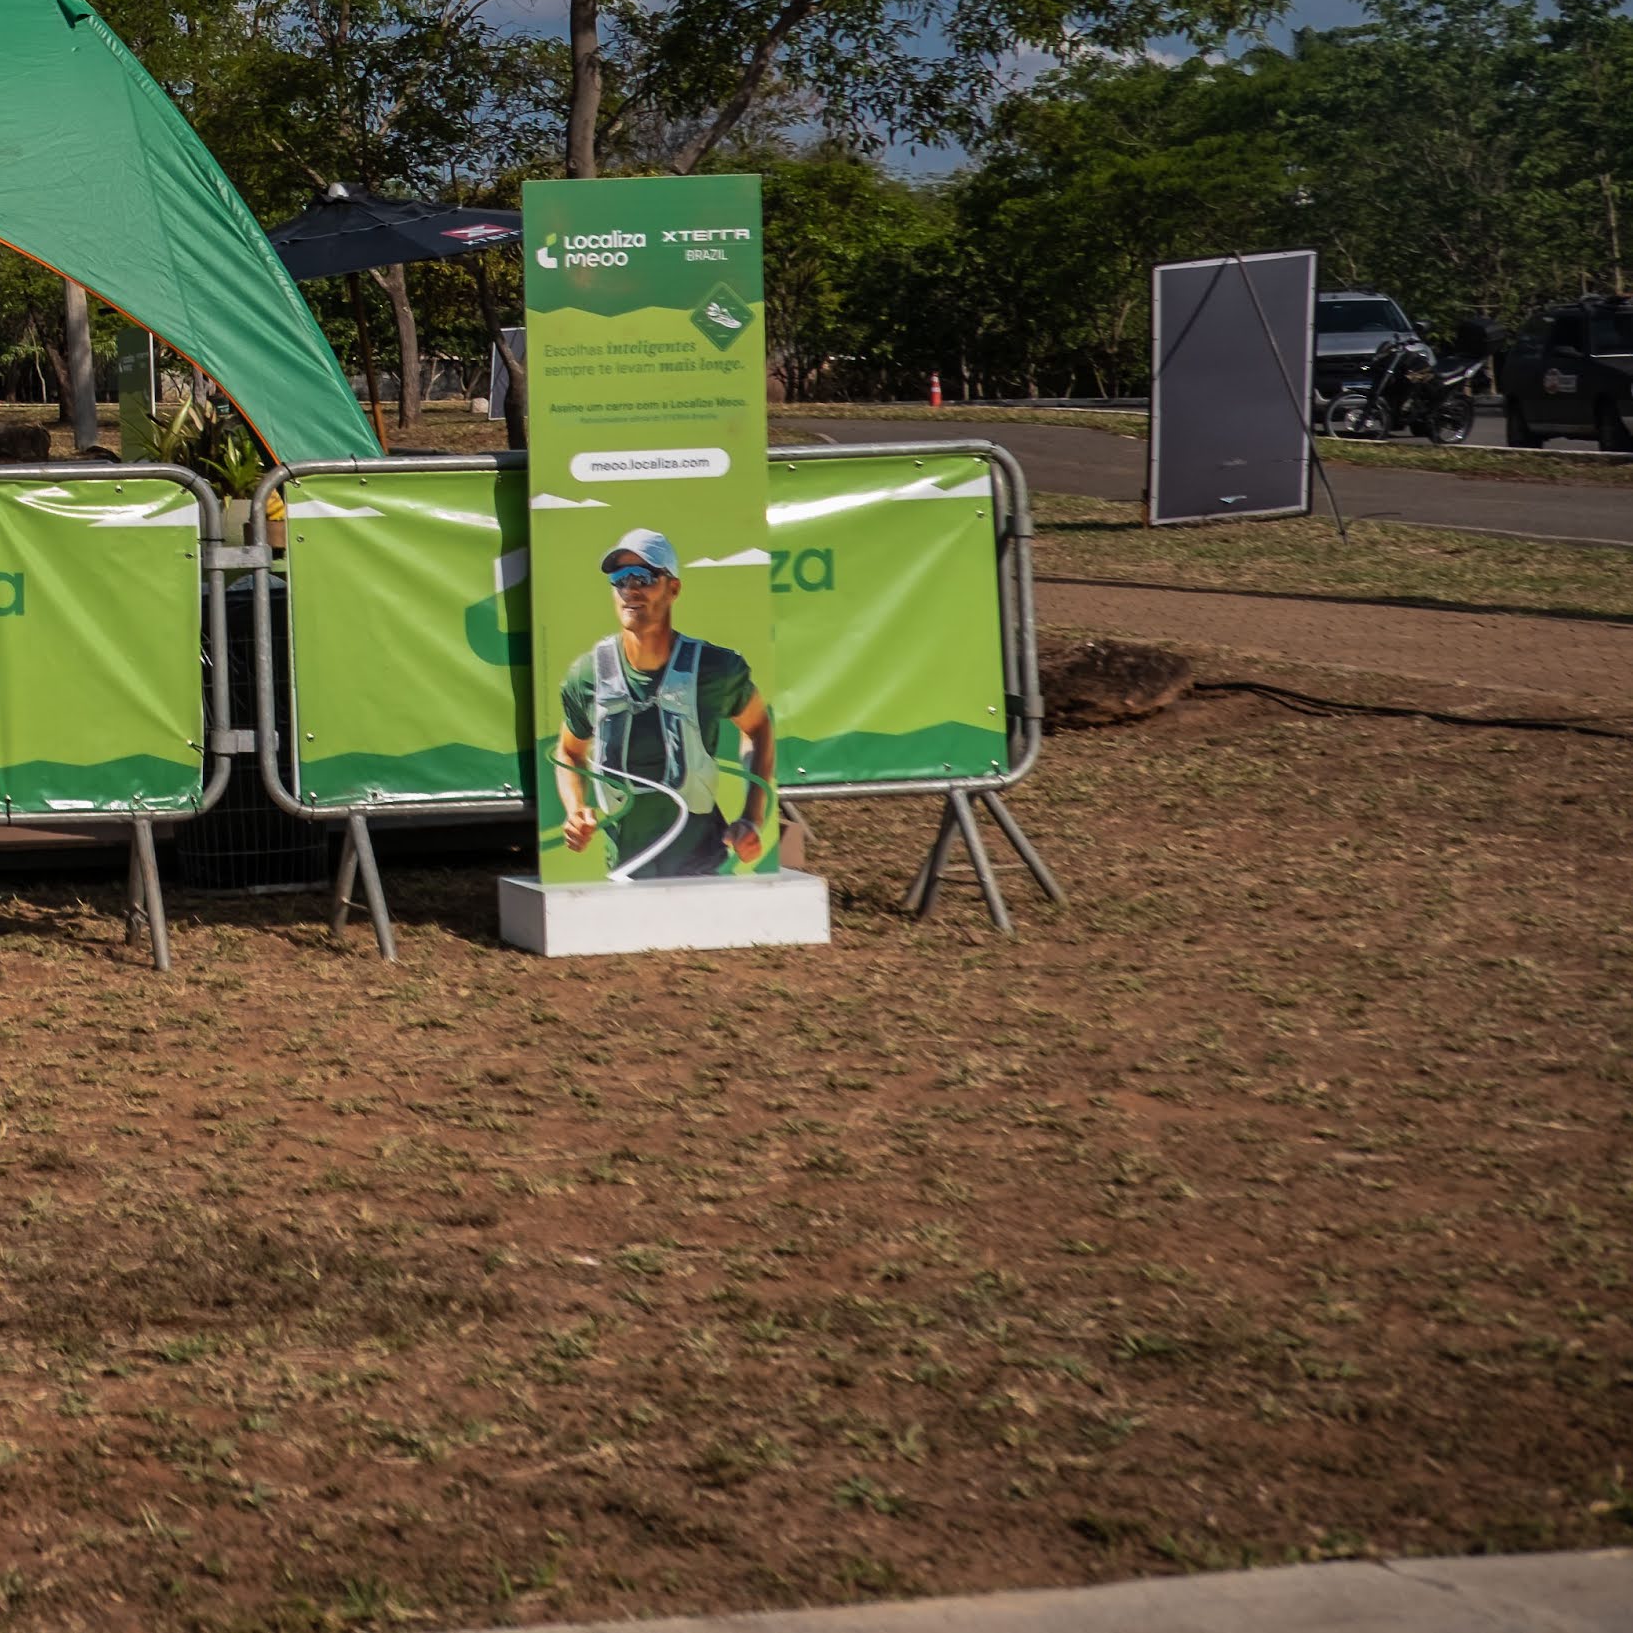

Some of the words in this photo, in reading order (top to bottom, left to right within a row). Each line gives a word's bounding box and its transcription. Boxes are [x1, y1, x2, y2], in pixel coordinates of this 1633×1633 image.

[563, 230, 647, 250] Localiza
[564, 251, 629, 268] meoo
[685, 249, 728, 262] BRAZIL
[544, 344, 603, 357] Escolhas
[606, 340, 697, 358] inteligentes
[544, 365, 595, 377] sempre
[599, 364, 612, 375] te
[659, 360, 696, 373] mais
[591, 457, 710, 472] meoo.localiza.com
